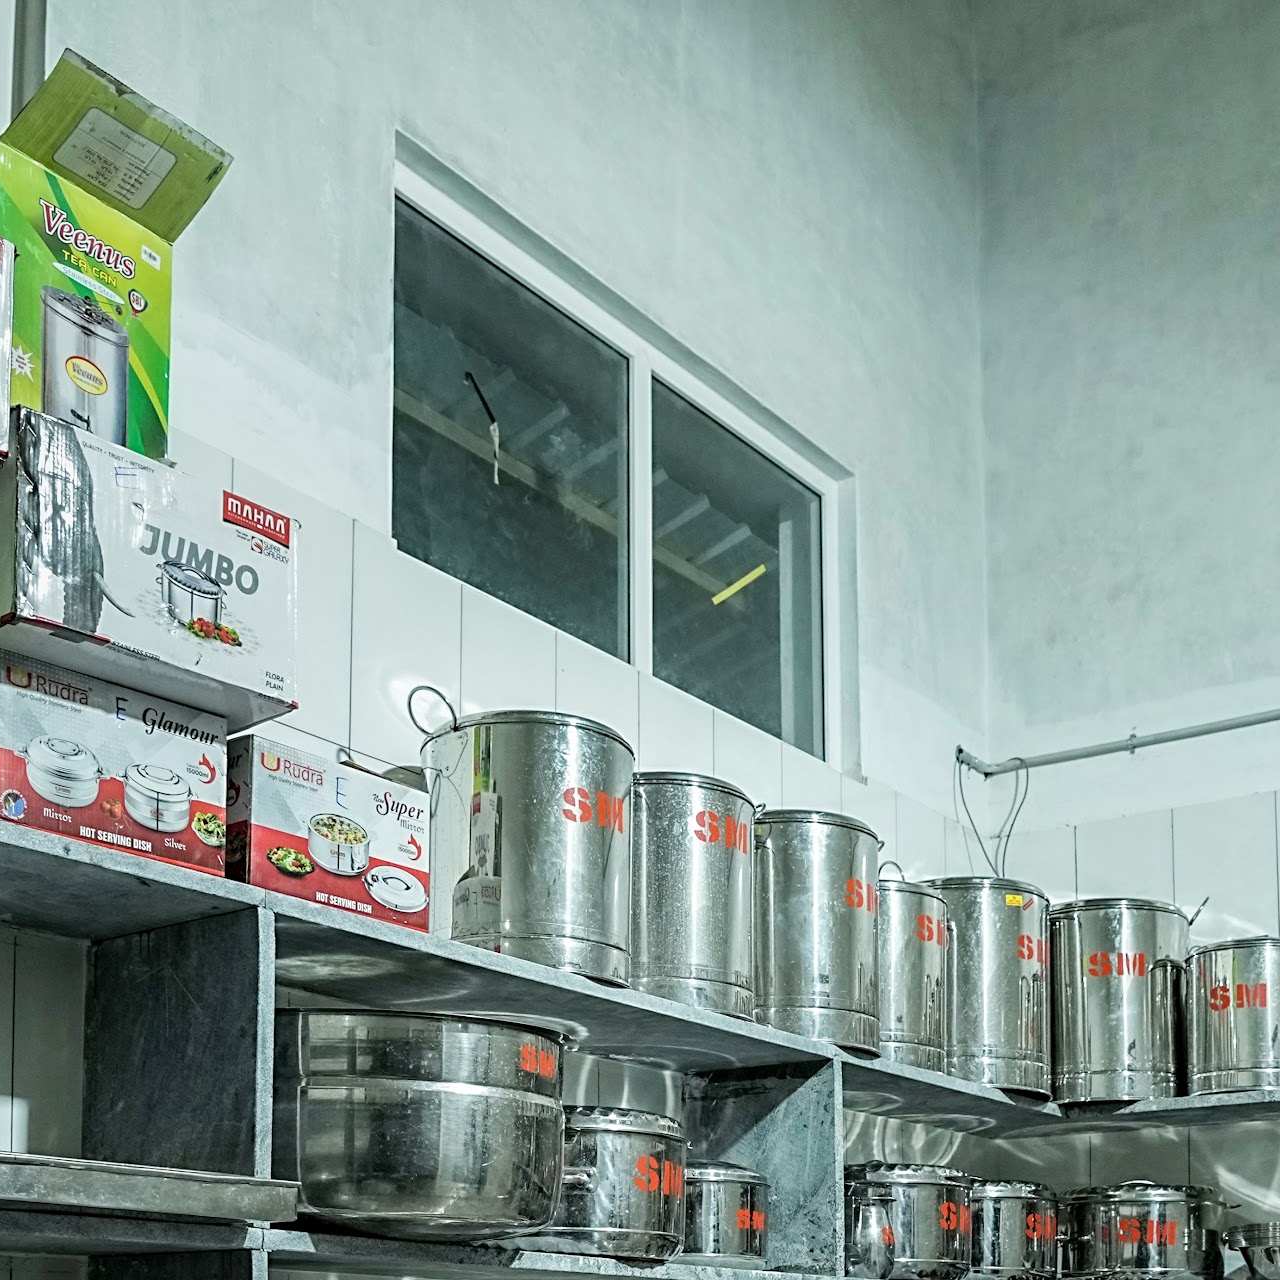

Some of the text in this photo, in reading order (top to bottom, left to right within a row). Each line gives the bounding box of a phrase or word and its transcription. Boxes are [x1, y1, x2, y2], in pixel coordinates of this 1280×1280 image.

[39, 198, 136, 280] Veenus
[62, 250, 117, 287] TEA CAN
[62, 266, 116, 301] Stainless Steel
[82, 441, 155, 473] QUALITY TRUST INTEGRITY
[139, 524, 260, 595] JUMBO
[36, 675, 88, 705] Rudra
[265, 671, 285, 684] FLORA
[265, 680, 284, 692] PLAIN
[142, 707, 219, 745] Glamour
[283, 759, 323, 786] Rudra
[43, 808, 72, 823] Mirror
[376, 791, 424, 821] Super
[562, 788, 624, 833] SM
[79, 826, 152, 852] HOT SERVING DISH
[400, 820, 425, 834] Mirror
[695, 810, 748, 854] SM
[164, 837, 187, 851] Silver
[316, 891, 372, 914] HOT SERVING DISH
[1088, 951, 1146, 978] SM
[1210, 983, 1267, 1012] SM
[520, 1045, 555, 1079] SM
[634, 1156, 682, 1198] SM
[735, 1208, 765, 1231] SM
[1117, 1218, 1177, 1246] SM
